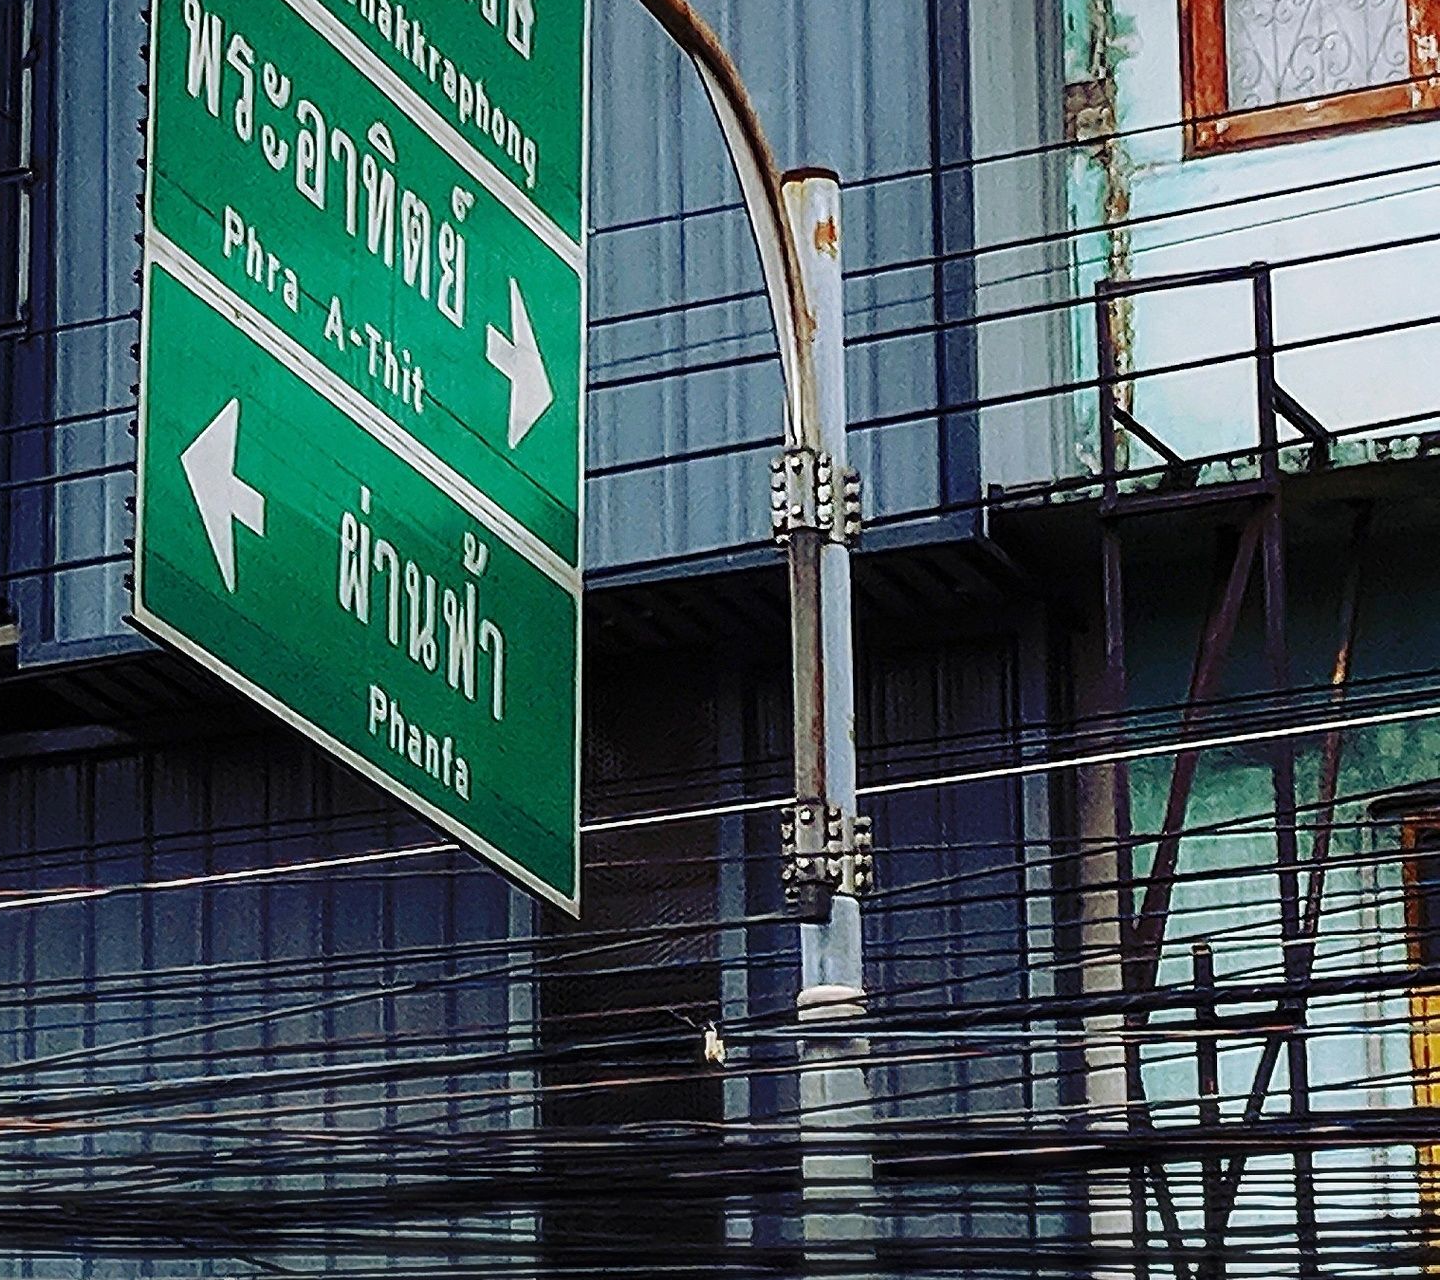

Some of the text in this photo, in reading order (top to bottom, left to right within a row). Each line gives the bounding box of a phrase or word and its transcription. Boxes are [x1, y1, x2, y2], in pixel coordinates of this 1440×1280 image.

[223, 205, 423, 414] Phra A-Thit
[339, 485, 503, 720] ผ่านฟ้า
